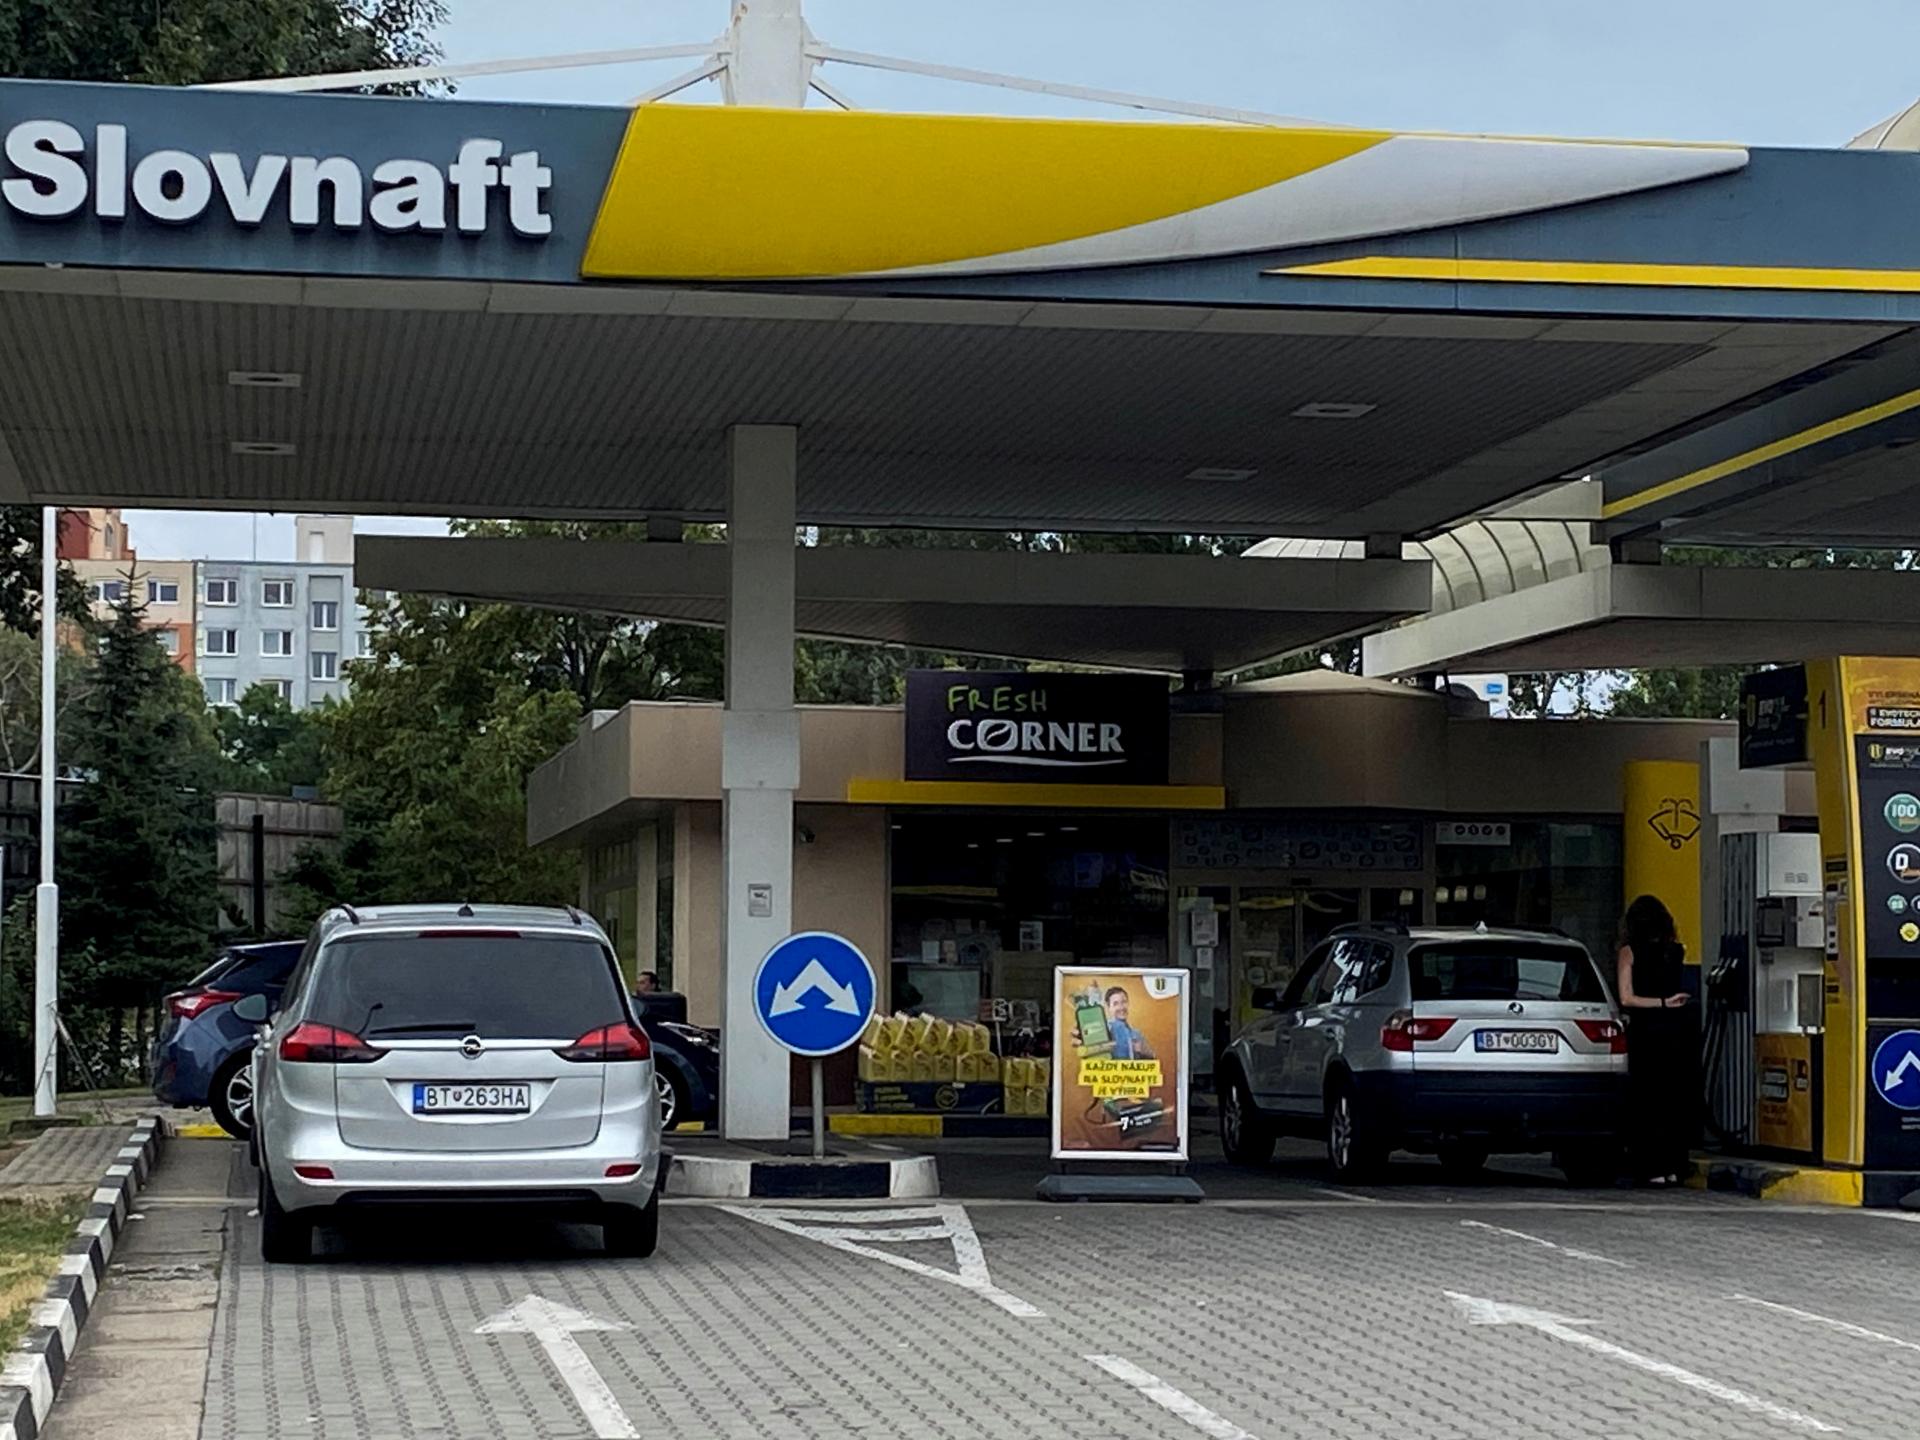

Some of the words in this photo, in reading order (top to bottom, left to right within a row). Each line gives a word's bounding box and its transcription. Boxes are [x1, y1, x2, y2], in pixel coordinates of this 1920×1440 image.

[1, 119, 553, 236] Slovnaft
[947, 718, 1125, 752] CORNER
[1891, 803, 1917, 818] 100
[1895, 852, 1909, 871] D
